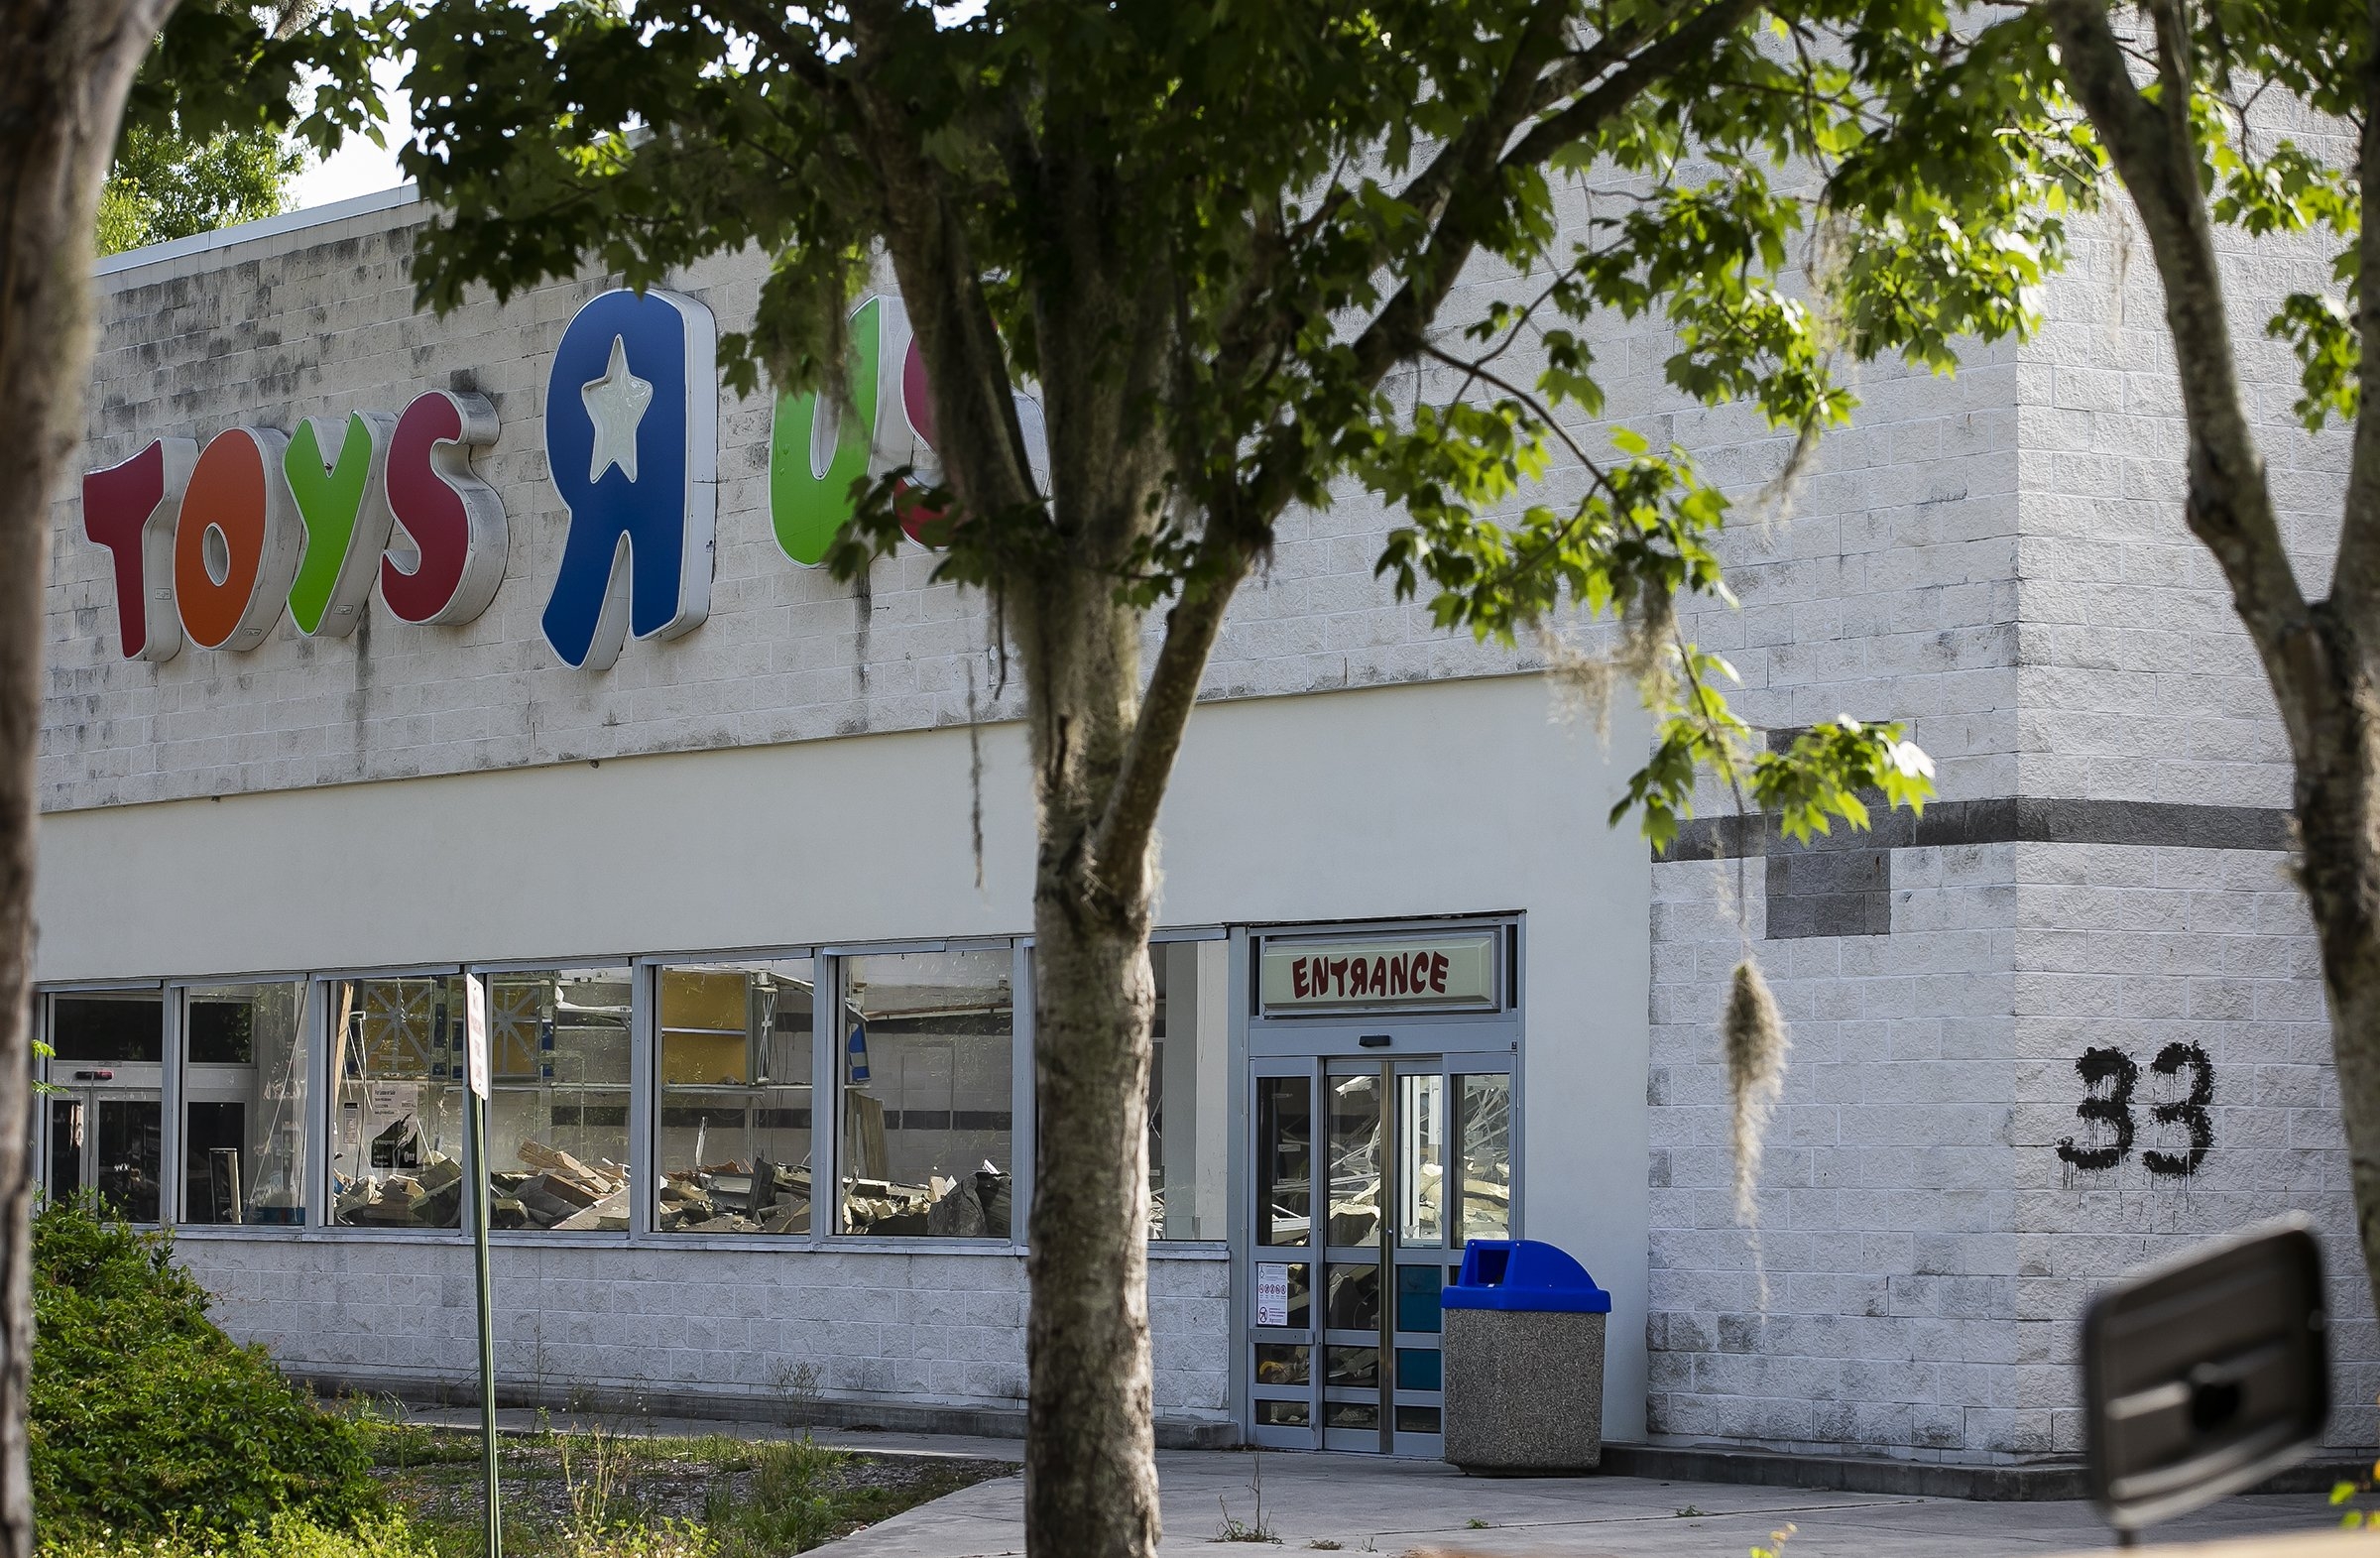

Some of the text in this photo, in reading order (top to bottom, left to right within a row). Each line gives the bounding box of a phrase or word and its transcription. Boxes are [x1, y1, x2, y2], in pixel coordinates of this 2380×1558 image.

[82, 389, 501, 661] TOYS
[1291, 950, 1450, 1000] ENTRANCE
[2056, 1040, 2216, 1176] 33
